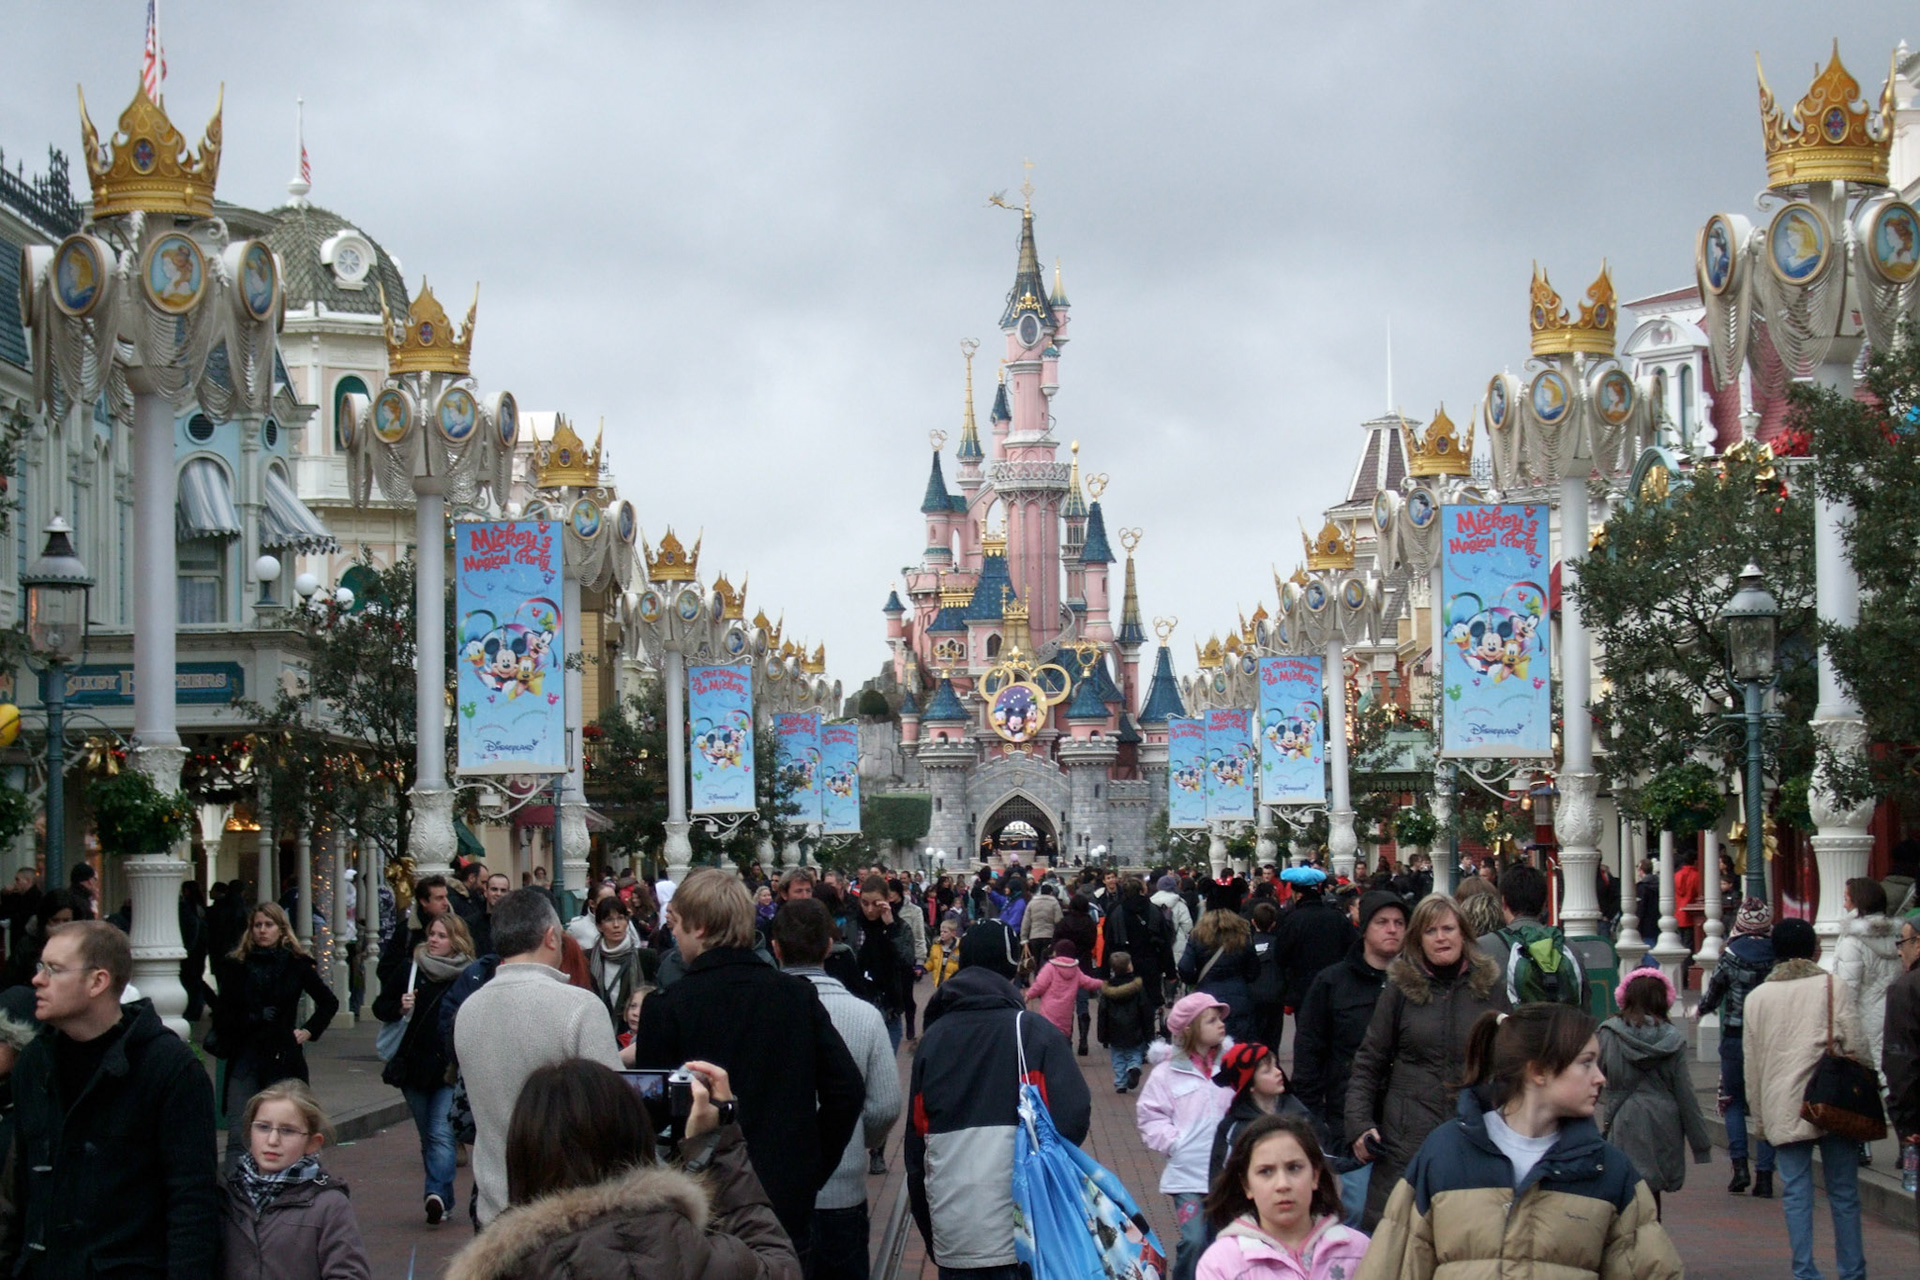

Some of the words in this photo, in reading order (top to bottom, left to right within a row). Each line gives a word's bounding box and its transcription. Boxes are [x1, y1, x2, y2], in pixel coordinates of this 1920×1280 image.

[1456, 506, 1539, 538] Mickey's
[470, 522, 552, 555] Mickey's
[1448, 533, 1496, 554] Magical
[1500, 530, 1543, 558] Party
[463, 549, 510, 572] Magical
[514, 547, 557, 574] Party
